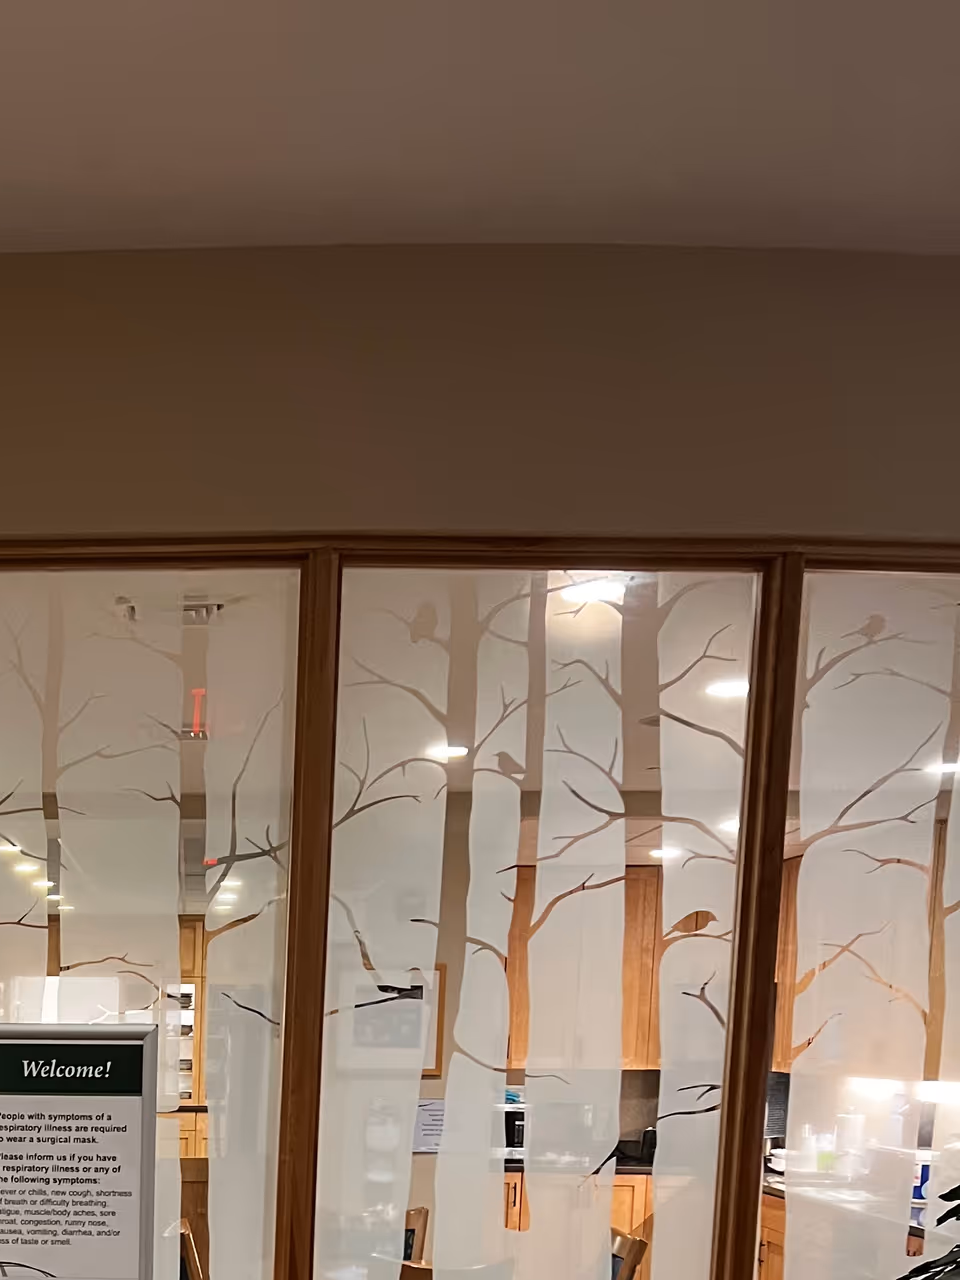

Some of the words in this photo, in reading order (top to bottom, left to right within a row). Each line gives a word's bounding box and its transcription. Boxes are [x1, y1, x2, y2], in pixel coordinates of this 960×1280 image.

[22, 1059, 112, 1078] Welcome!
[48, 1114, 93, 1122] symptoms
[95, 1113, 105, 1121] of
[44, 1125, 72, 1133] illness
[90, 1125, 127, 1133] required
[36, 1136, 71, 1145] surgical
[73, 1136, 99, 1144] mask.
[26, 1153, 54, 1161] inform
[69, 1154, 76, 1162] if
[77, 1156, 94, 1164] you
[96, 1154, 117, 1162] have
[2, 1165, 49, 1174] respiratory
[51, 1165, 80, 1173] illness
[93, 1167, 110, 1175] any
[111, 1166, 121, 1174] of
[10, 1175, 50, 1185] following
[52, 1177, 101, 1185] symptoms:
[68, 1190, 94, 1198] cough,
[4, 1198, 28, 1206] breath
[39, 1199, 70, 1207] difficulty
[23, 1209, 71, 1217] muscle/body
[64, 1220, 86, 1228] runny
[20, 1238, 39, 1246] taste
